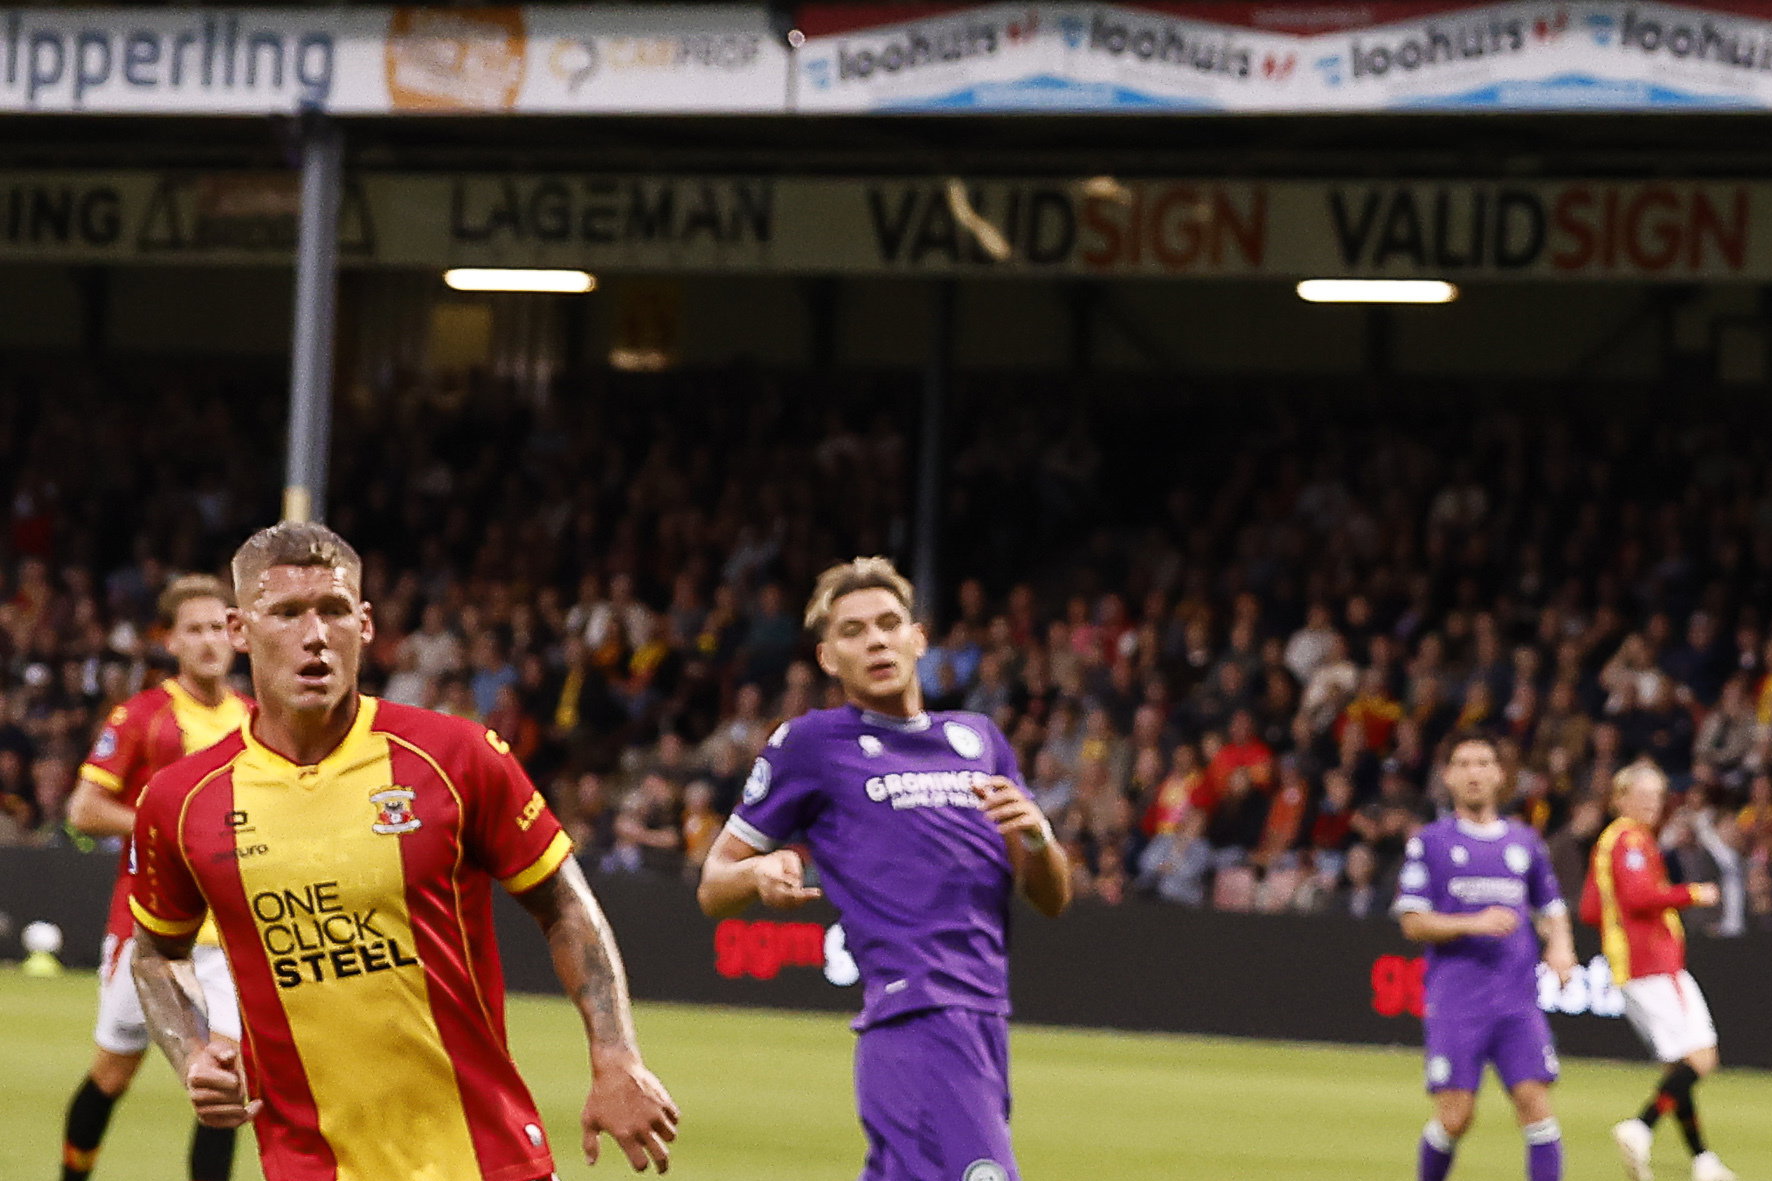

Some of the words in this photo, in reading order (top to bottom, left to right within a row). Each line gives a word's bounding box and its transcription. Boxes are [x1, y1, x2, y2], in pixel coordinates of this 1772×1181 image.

[838, 23, 998, 80] loohuis
[1089, 12, 1251, 79] loohuis
[1351, 20, 1525, 78] loohuis
[450, 174, 776, 245] LAGEMAN
[1329, 184, 1750, 270] VALIDSIGN
[253, 880, 344, 923] ONE
[263, 908, 384, 956] CLICK
[273, 938, 419, 988] STEEL
